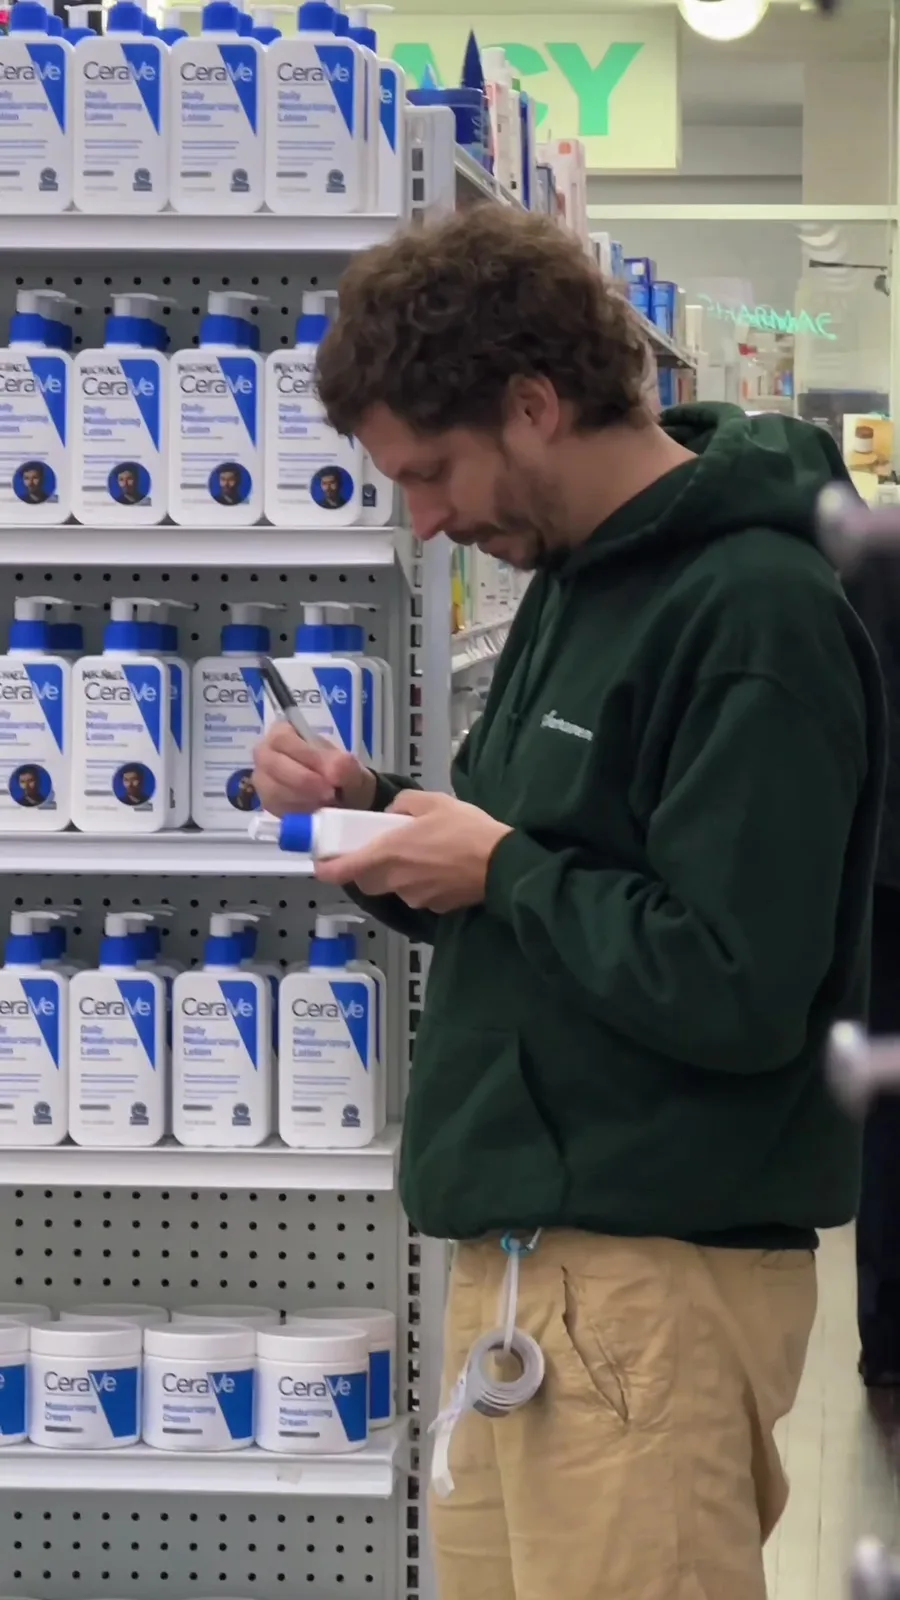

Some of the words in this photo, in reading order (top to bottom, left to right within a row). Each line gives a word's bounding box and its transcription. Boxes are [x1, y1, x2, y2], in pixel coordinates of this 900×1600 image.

[0, 61, 61, 81] eraVe
[83, 61, 156, 81] CeraVe
[180, 61, 253, 82] CeraVe
[277, 62, 350, 83] CeraVe
[0, 374, 61, 393] eraVe
[82, 376, 154, 396] CeraVe
[180, 374, 253, 394] CeraVe
[0, 681, 59, 701] eraVe
[84, 681, 157, 701] CeraVe
[202, 684, 264, 703] CeraV
[293, 684, 348, 704] eraVe
[0, 996, 55, 1016] eraVe
[79, 996, 150, 1016] CeraVe
[181, 997, 253, 1017] CeraVe
[292, 998, 364, 1019] CeraVe
[44, 1371, 117, 1392] CeraVe
[162, 1372, 235, 1394] CeraVe
[278, 1376, 351, 1397] CeraVe
